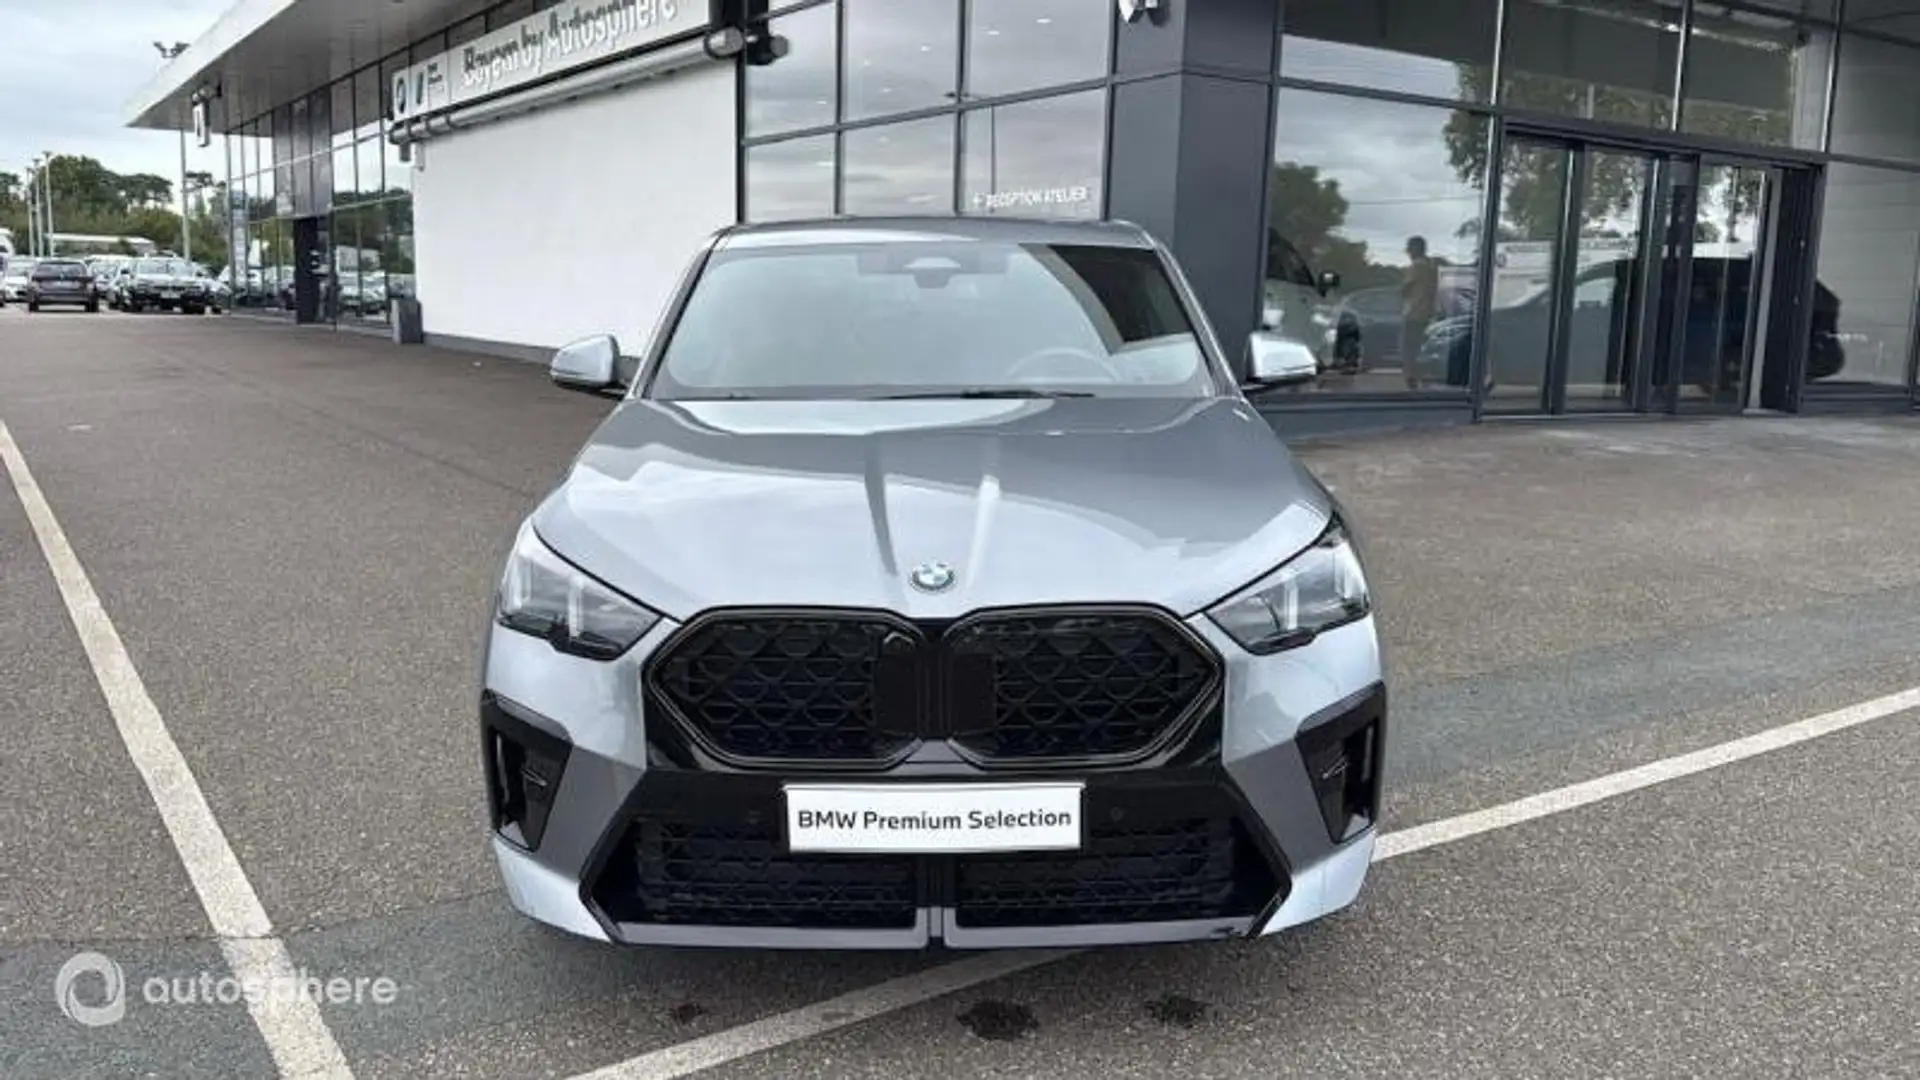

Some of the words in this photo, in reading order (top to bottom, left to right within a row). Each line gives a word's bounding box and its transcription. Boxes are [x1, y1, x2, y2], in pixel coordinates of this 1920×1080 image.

[799, 810, 857, 829] BMW
[863, 810, 962, 830] Premium
[968, 808, 1072, 829] Selection
